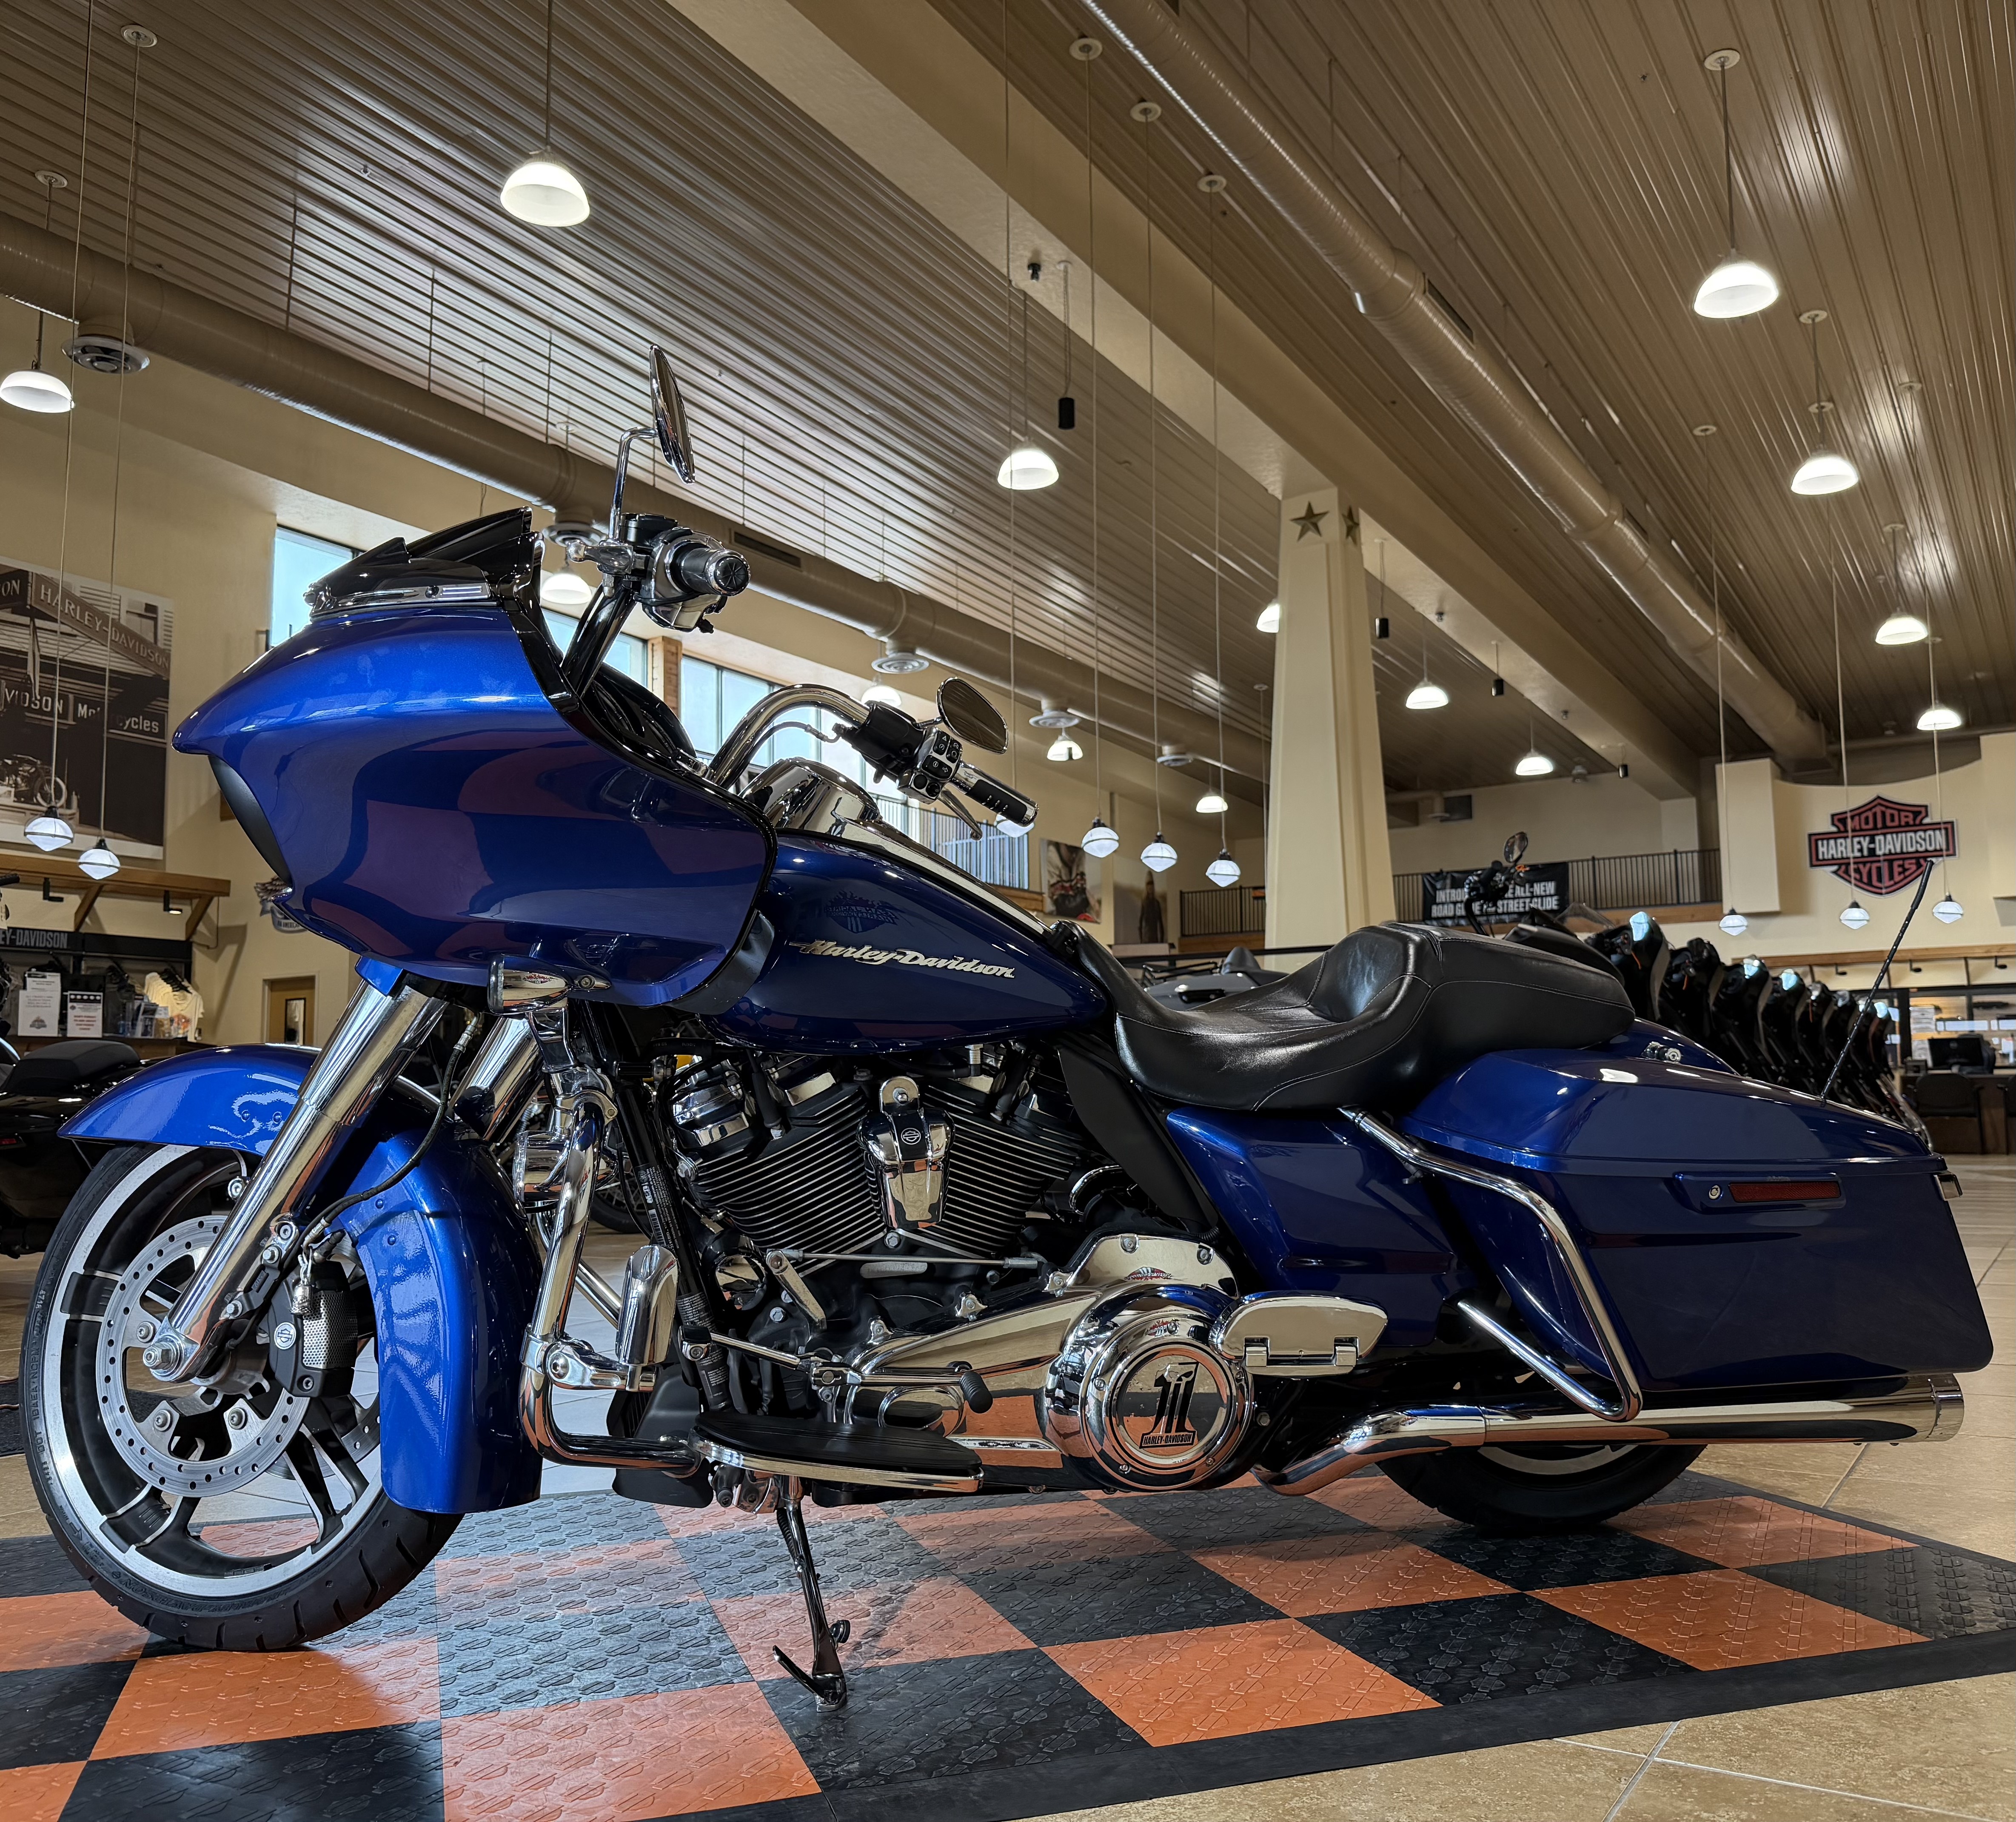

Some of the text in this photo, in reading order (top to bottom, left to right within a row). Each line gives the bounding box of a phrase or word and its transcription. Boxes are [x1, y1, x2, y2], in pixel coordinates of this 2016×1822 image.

[0, 579, 20, 596] ON
[41, 584, 169, 669] HARLEY-DAVIDSON
[1848, 806, 1914, 830] MOTOR
[1817, 829, 1946, 860] HARLEY-DAVIDSON
[1848, 858, 1917, 888] CYCLES
[1515, 881, 1555, 897] ALL-NEW
[1431, 902, 1454, 918] ROAD
[1497, 898, 1531, 914] STREET
[790, 939, 1015, 978] Harley-Davidson
[34, 1430, 45, 1454] DOT
[1143, 1434, 1192, 1445] HARLEY-DAVIDSON
